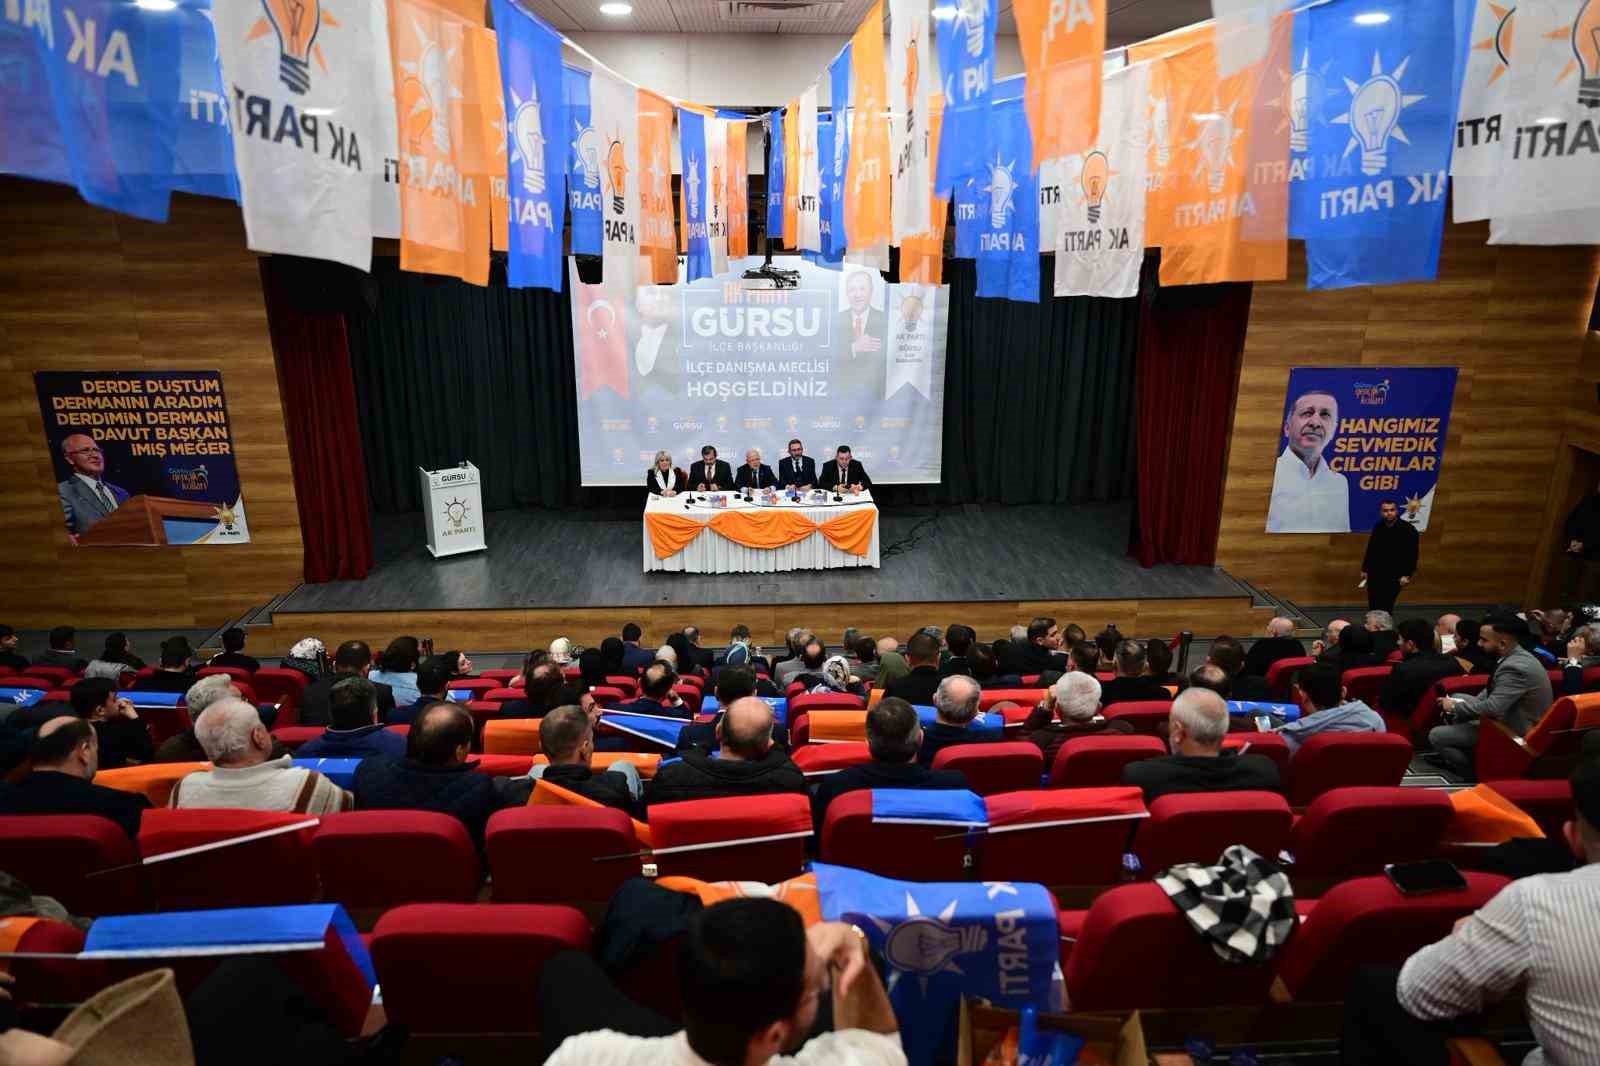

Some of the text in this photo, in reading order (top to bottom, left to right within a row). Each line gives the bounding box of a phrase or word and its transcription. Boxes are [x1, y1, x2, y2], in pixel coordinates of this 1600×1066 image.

[82, 379, 221, 397] DERDE DÜŞTÜM
[687, 376, 828, 402] HOŞGELDİNİZ
[52, 395, 223, 410] DERMANINI ARADIM
[145, 411, 226, 425] DERMANI
[92, 426, 228, 443] DAVUT BAŞKAN
[170, 439, 231, 457] MEĞER
